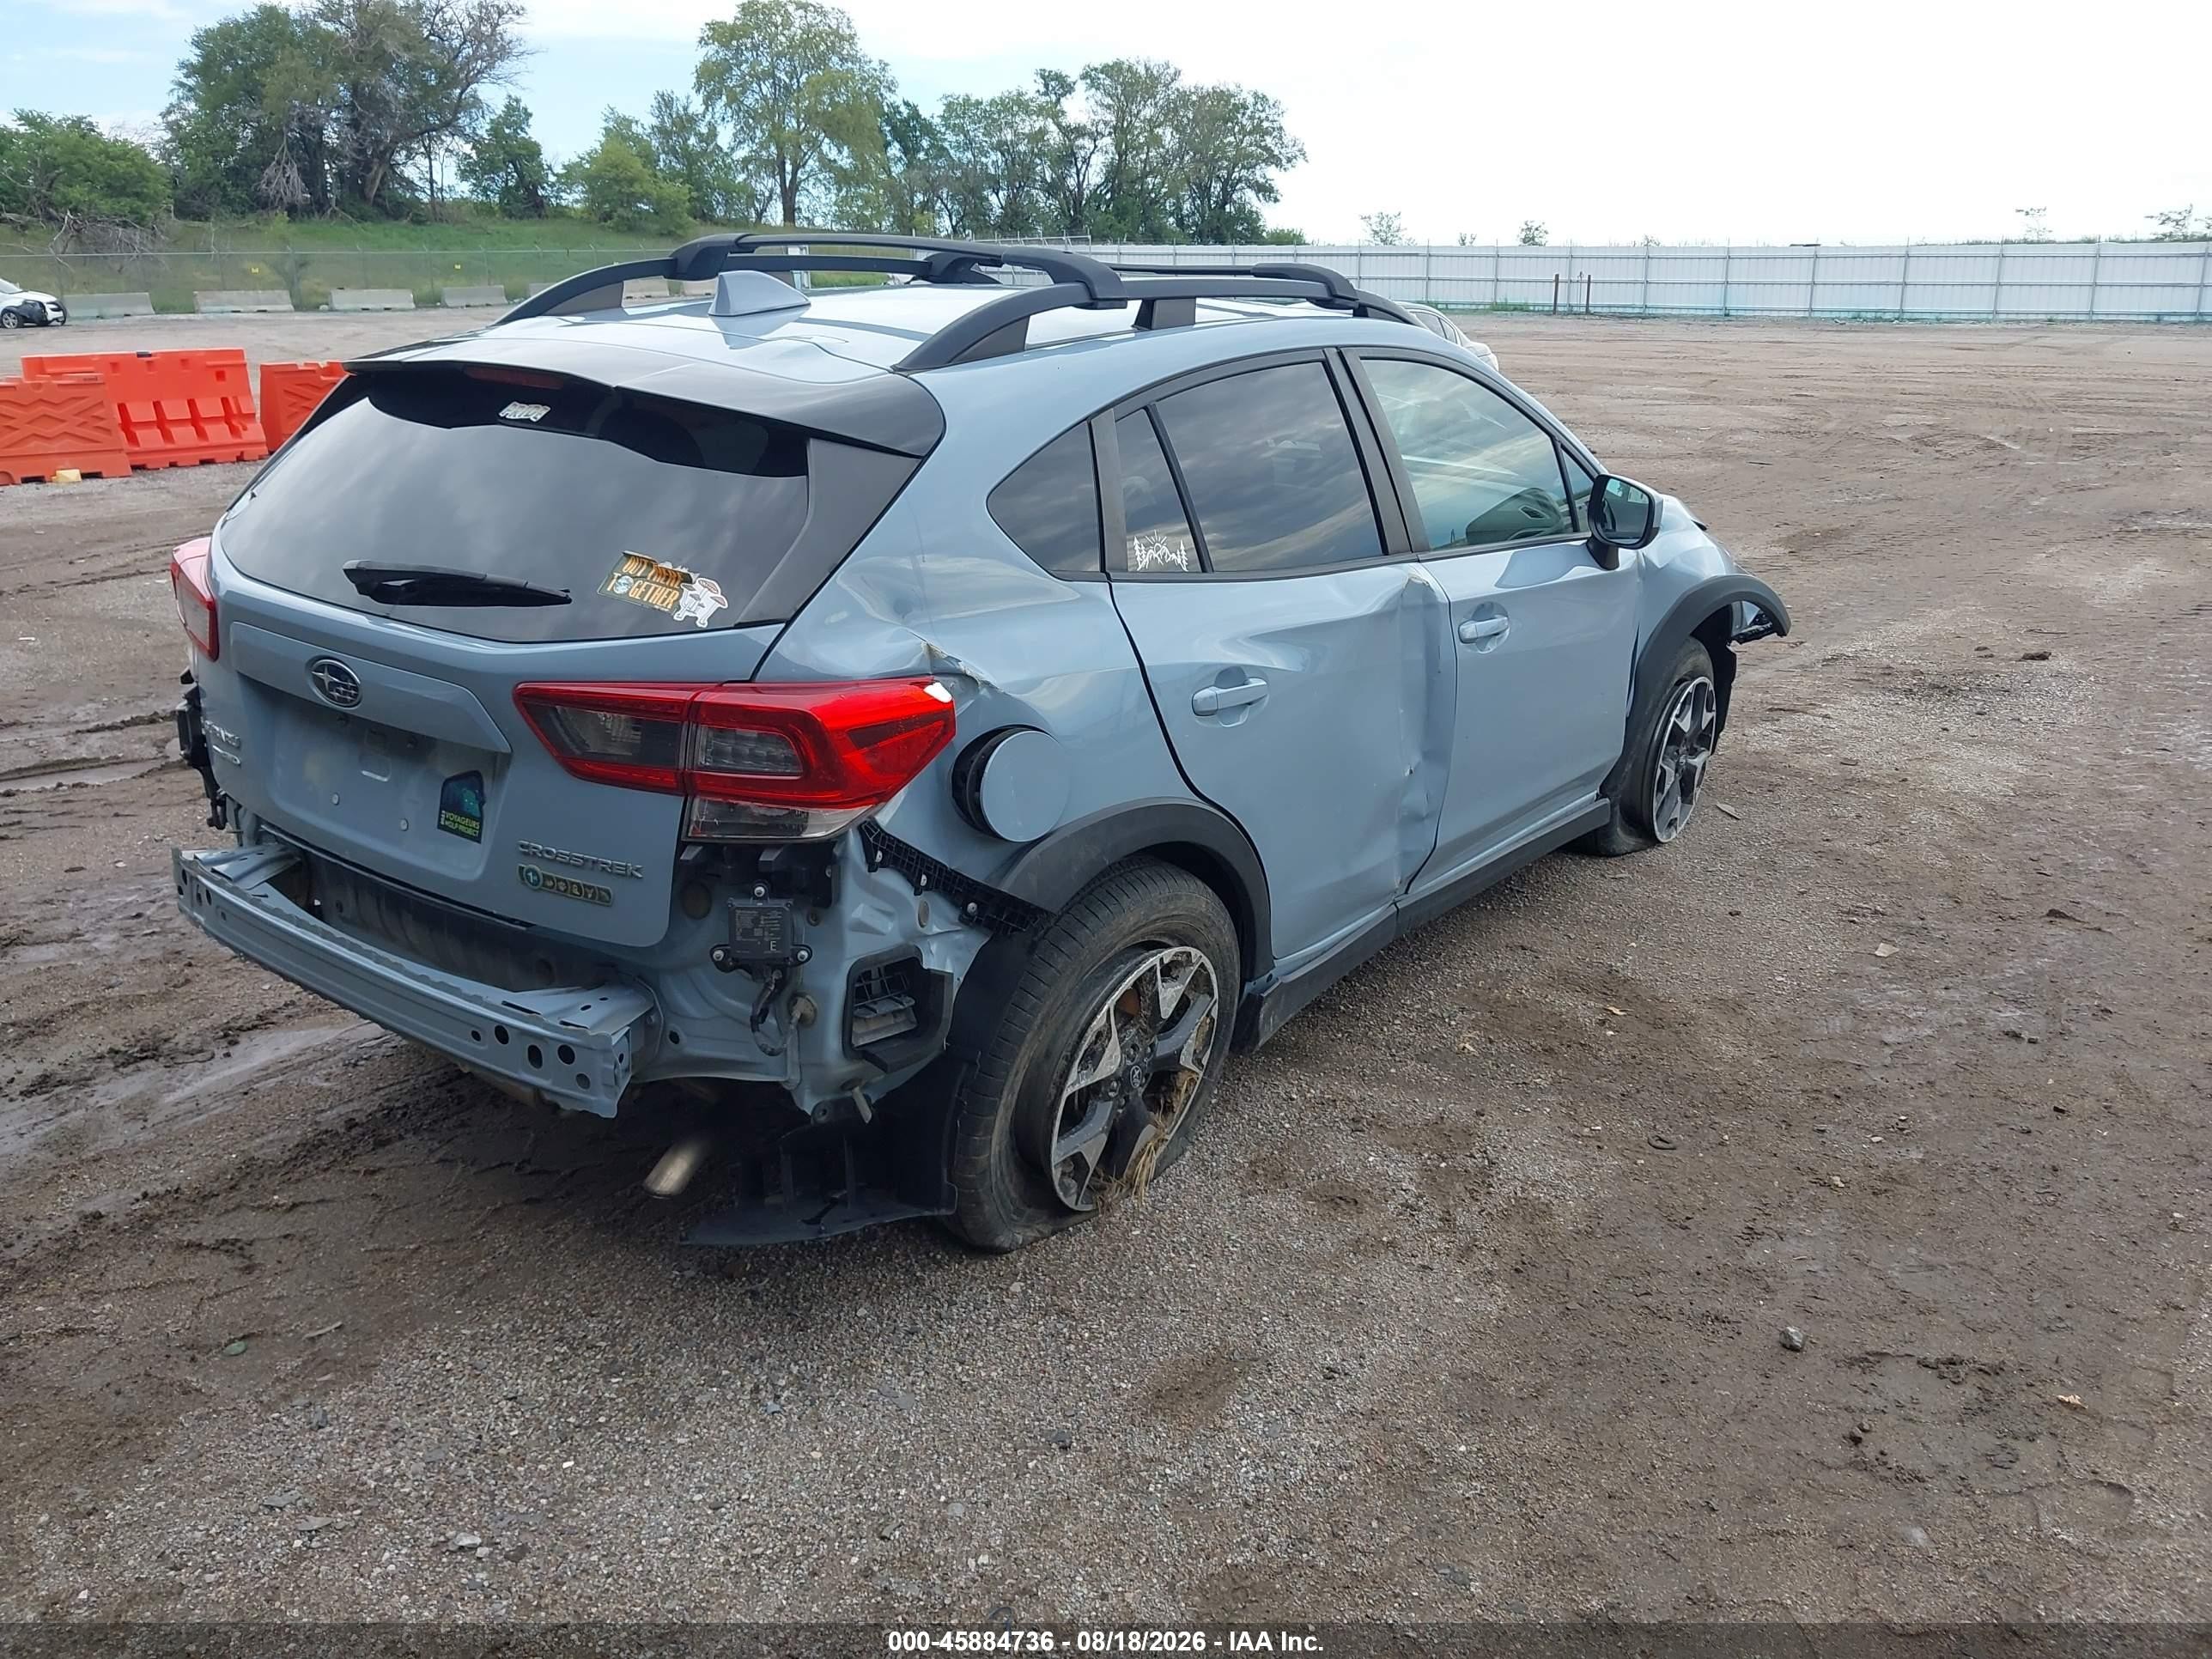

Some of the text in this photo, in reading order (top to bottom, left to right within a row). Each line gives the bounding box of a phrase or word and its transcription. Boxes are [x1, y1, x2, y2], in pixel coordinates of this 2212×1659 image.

[622, 556, 684, 588] OUT THERE
[517, 840, 644, 878] CROSSTREK
[769, 940, 777, 951] E
